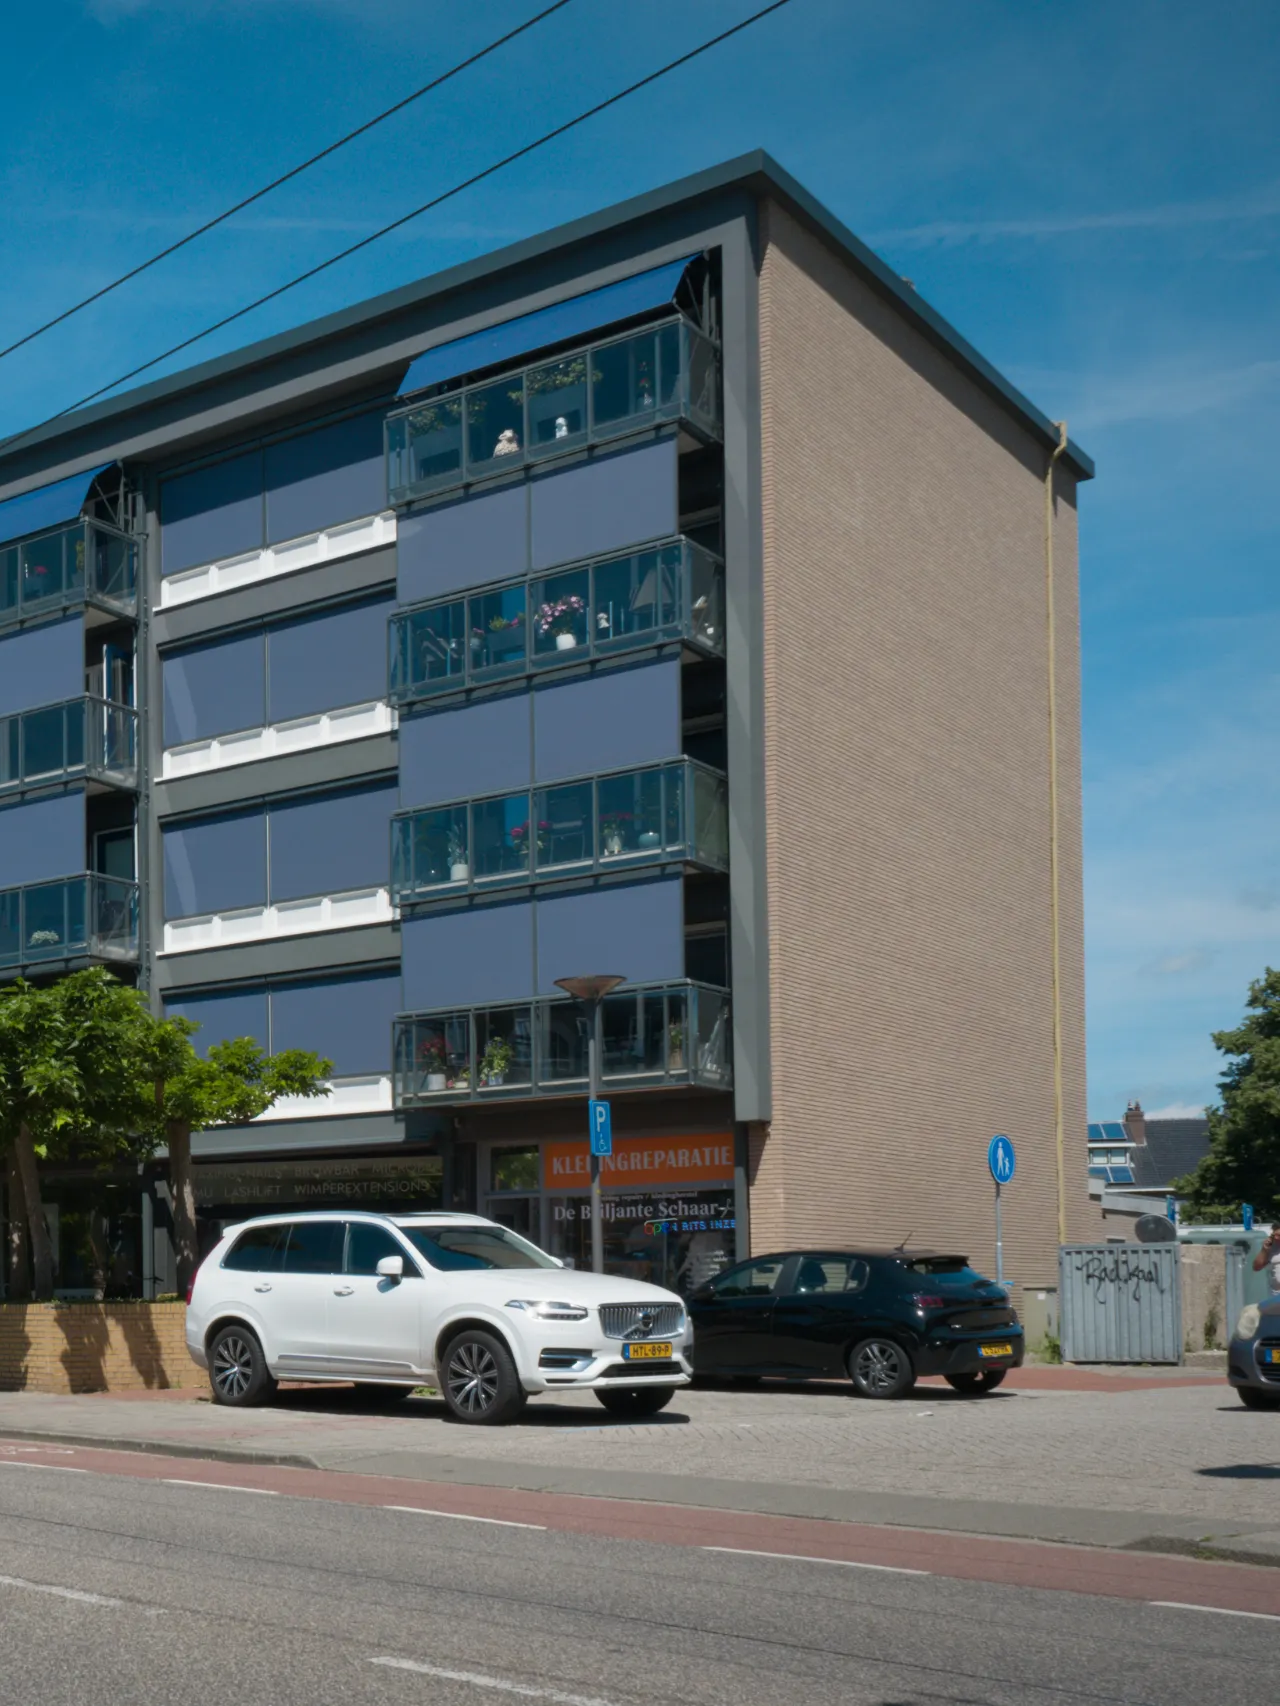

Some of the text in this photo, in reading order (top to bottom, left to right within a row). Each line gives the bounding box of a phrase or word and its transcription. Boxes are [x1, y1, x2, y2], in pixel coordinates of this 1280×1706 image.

[595, 1106, 606, 1132] P
[294, 1163, 360, 1178] BROWBAR
[224, 1185, 284, 1198] LASHLIFT
[293, 1179, 431, 1196] WIMPEREXTENSIONS
[554, 1199, 719, 1222] De Biljante Schaar
[681, 1220, 707, 1231] RITS
[632, 1344, 670, 1357] HTL-89-P
